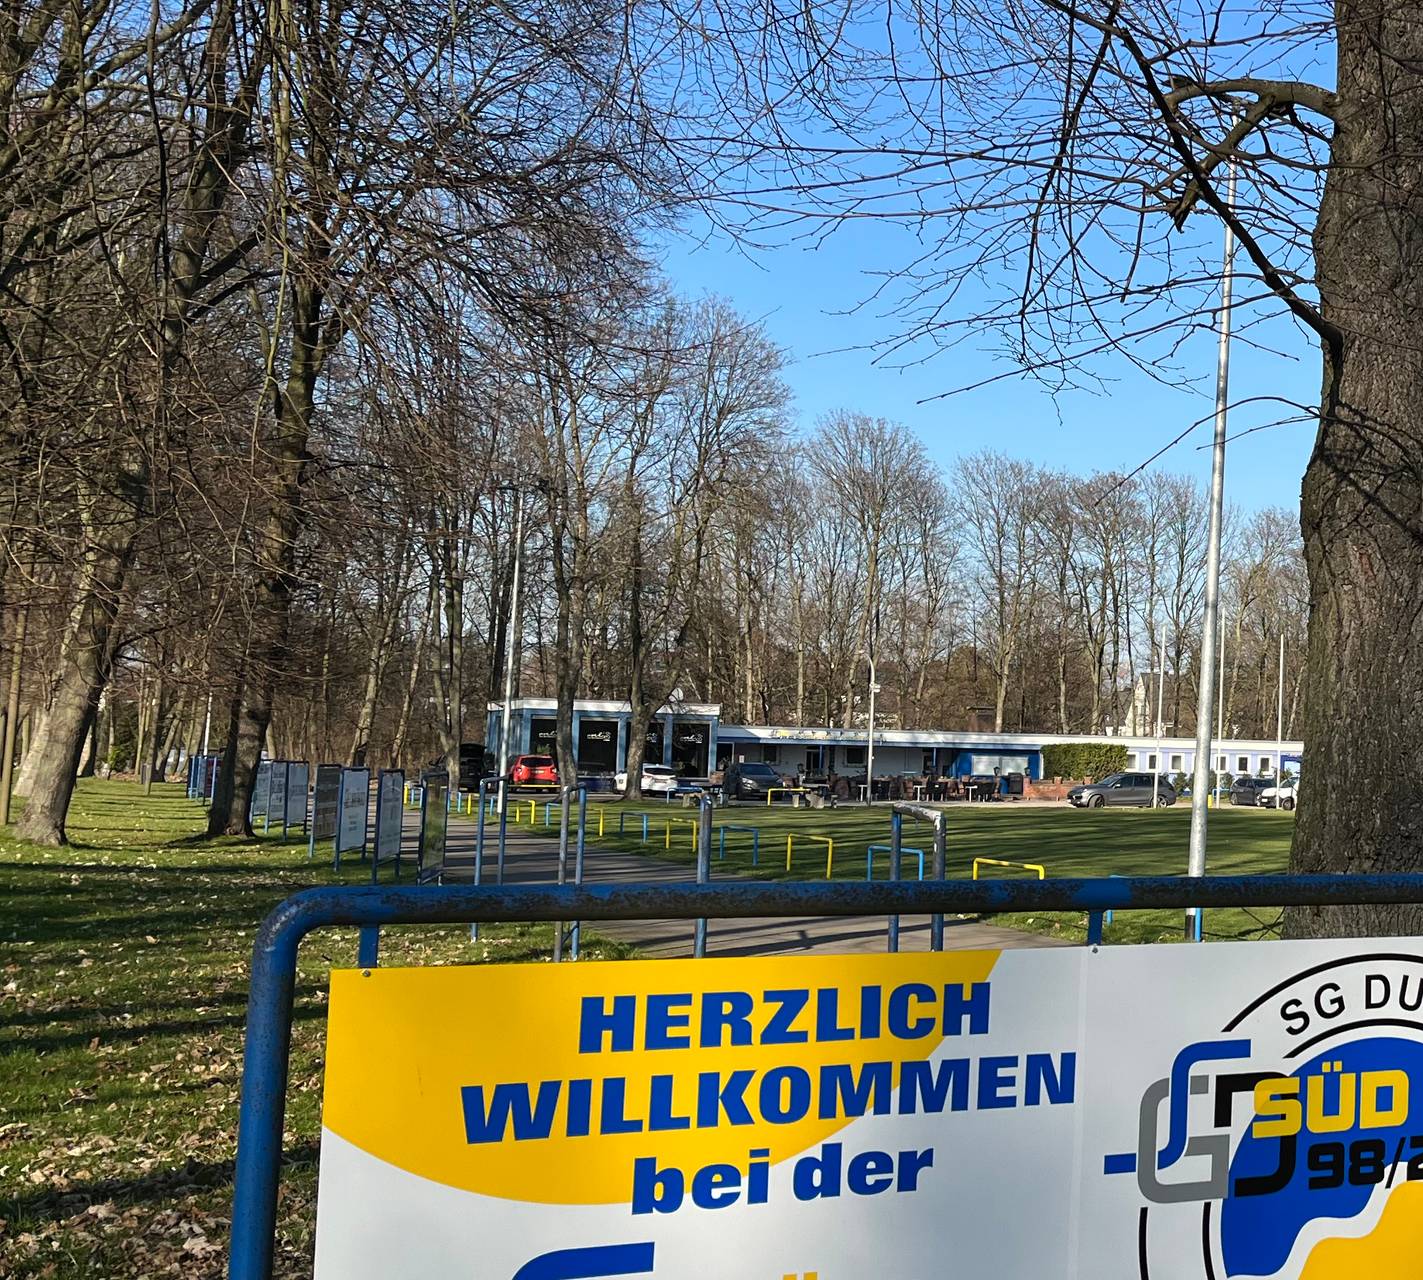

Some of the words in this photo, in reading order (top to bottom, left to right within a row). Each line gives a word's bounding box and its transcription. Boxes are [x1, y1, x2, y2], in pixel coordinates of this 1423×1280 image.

[577, 980, 991, 1053] HERZLICH
[1280, 981, 1346, 1036] SG
[460, 1051, 1076, 1144] WILLKOMMEN
[1252, 1060, 1410, 1139] SÜD
[631, 1148, 770, 1215] bei
[792, 1142, 934, 1202] der
